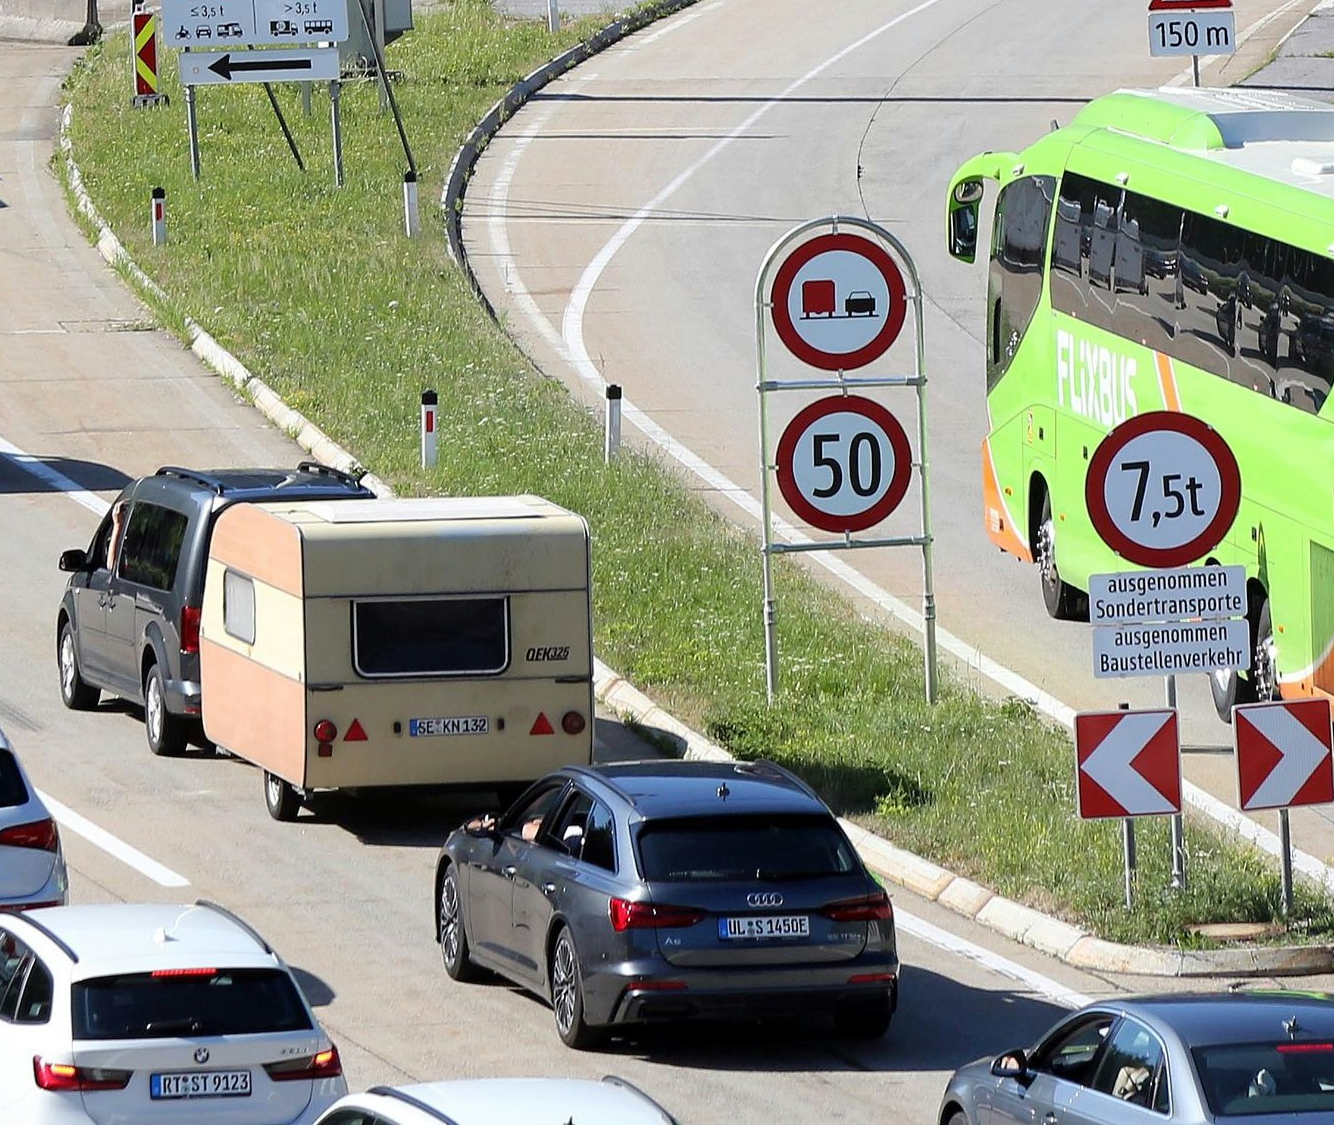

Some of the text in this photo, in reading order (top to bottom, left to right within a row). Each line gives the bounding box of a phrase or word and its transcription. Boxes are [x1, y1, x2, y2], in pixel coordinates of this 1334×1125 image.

[1156, 21, 1229, 47] 150 m
[813, 433, 883, 499] 50
[1108, 572, 1227, 596] ausgenommen
[1096, 593, 1241, 619] Sondertransporte
[1115, 626, 1227, 649] ausgenommen
[1100, 647, 1243, 673] Baustellenverkehr
[418, 719, 487, 734] SE KN 132
[728, 920, 745, 935] UL
[767, 918, 807, 933] 1450E
[163, 1074, 248, 1093] RT ST 9123
